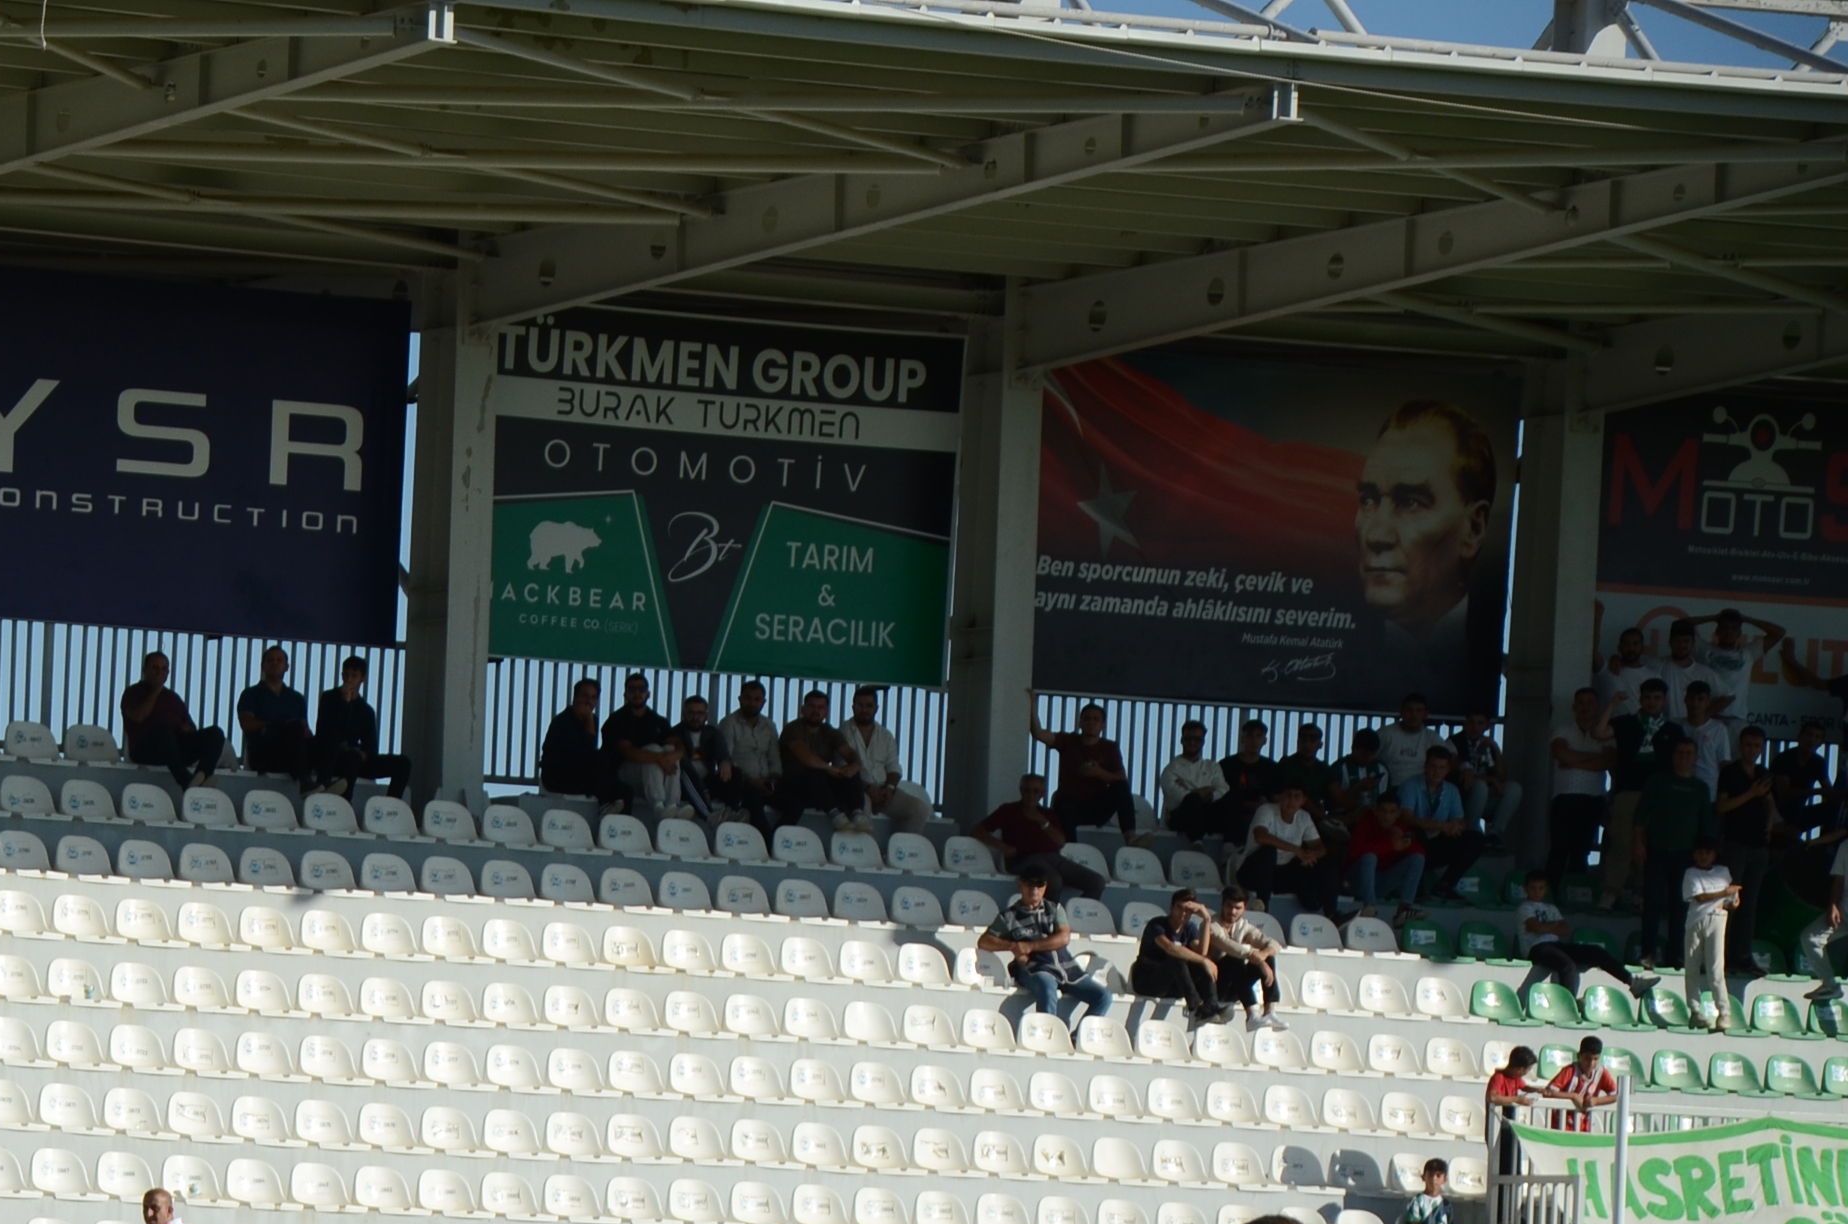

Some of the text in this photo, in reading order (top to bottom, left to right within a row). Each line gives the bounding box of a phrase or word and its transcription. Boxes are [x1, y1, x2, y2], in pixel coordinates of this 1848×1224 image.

[499, 315, 928, 403] TÜRKMEN GROUP
[557, 387, 860, 440] BURAK TURKMEN
[544, 438, 867, 492] OTOMOTİV
[787, 541, 874, 573] TARIM
[1036, 555, 1313, 595] Ben sporcunun zeki, çevik ve
[490, 580, 646, 611] ACKBEAR
[818, 585, 836, 607] &
[1034, 591, 1356, 630] aynı zamanda ahlâklısını severim.
[519, 613, 577, 628] COFFEE
[755, 613, 896, 650] SERACILIK
[1242, 632, 1343, 649] Mustafa Kemal Atatürk
